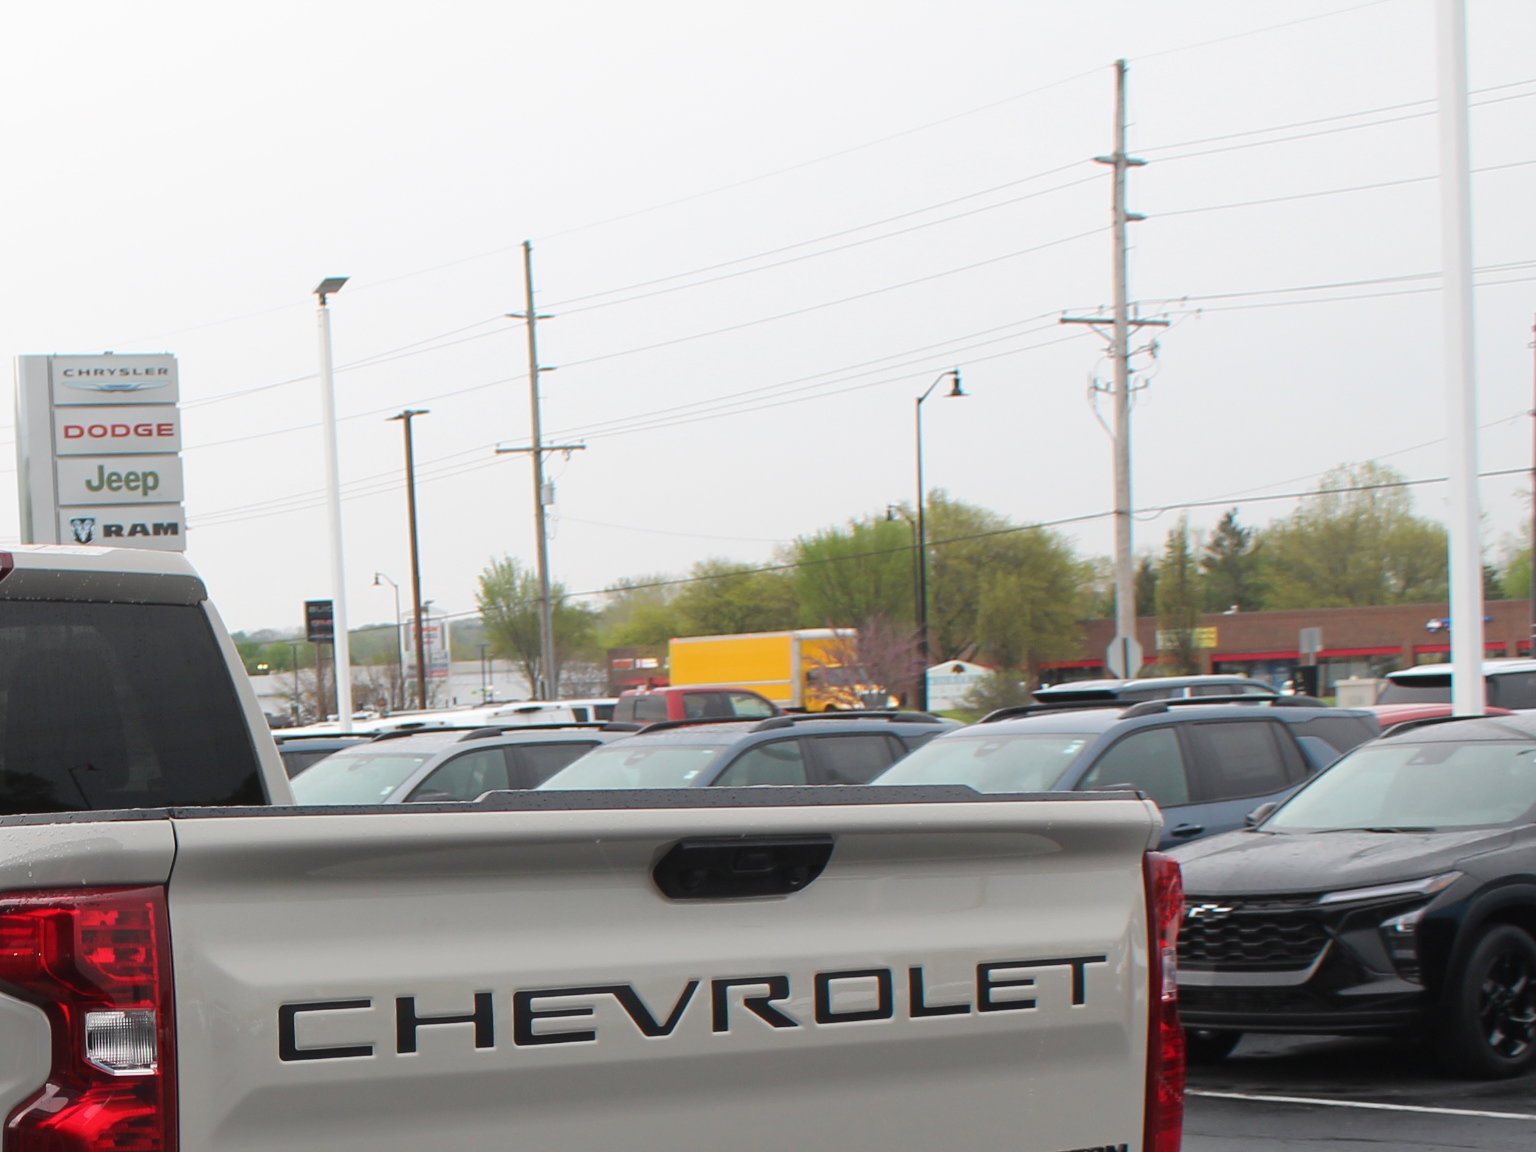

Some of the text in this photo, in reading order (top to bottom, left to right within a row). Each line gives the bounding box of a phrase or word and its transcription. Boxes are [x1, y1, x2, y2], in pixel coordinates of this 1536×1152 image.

[63, 367, 169, 377] CHRYSLER
[64, 422, 175, 439] DODGE
[85, 464, 160, 496] Jeep
[103, 522, 179, 538] RAM
[278, 955, 1108, 1061] CHEVROLET
